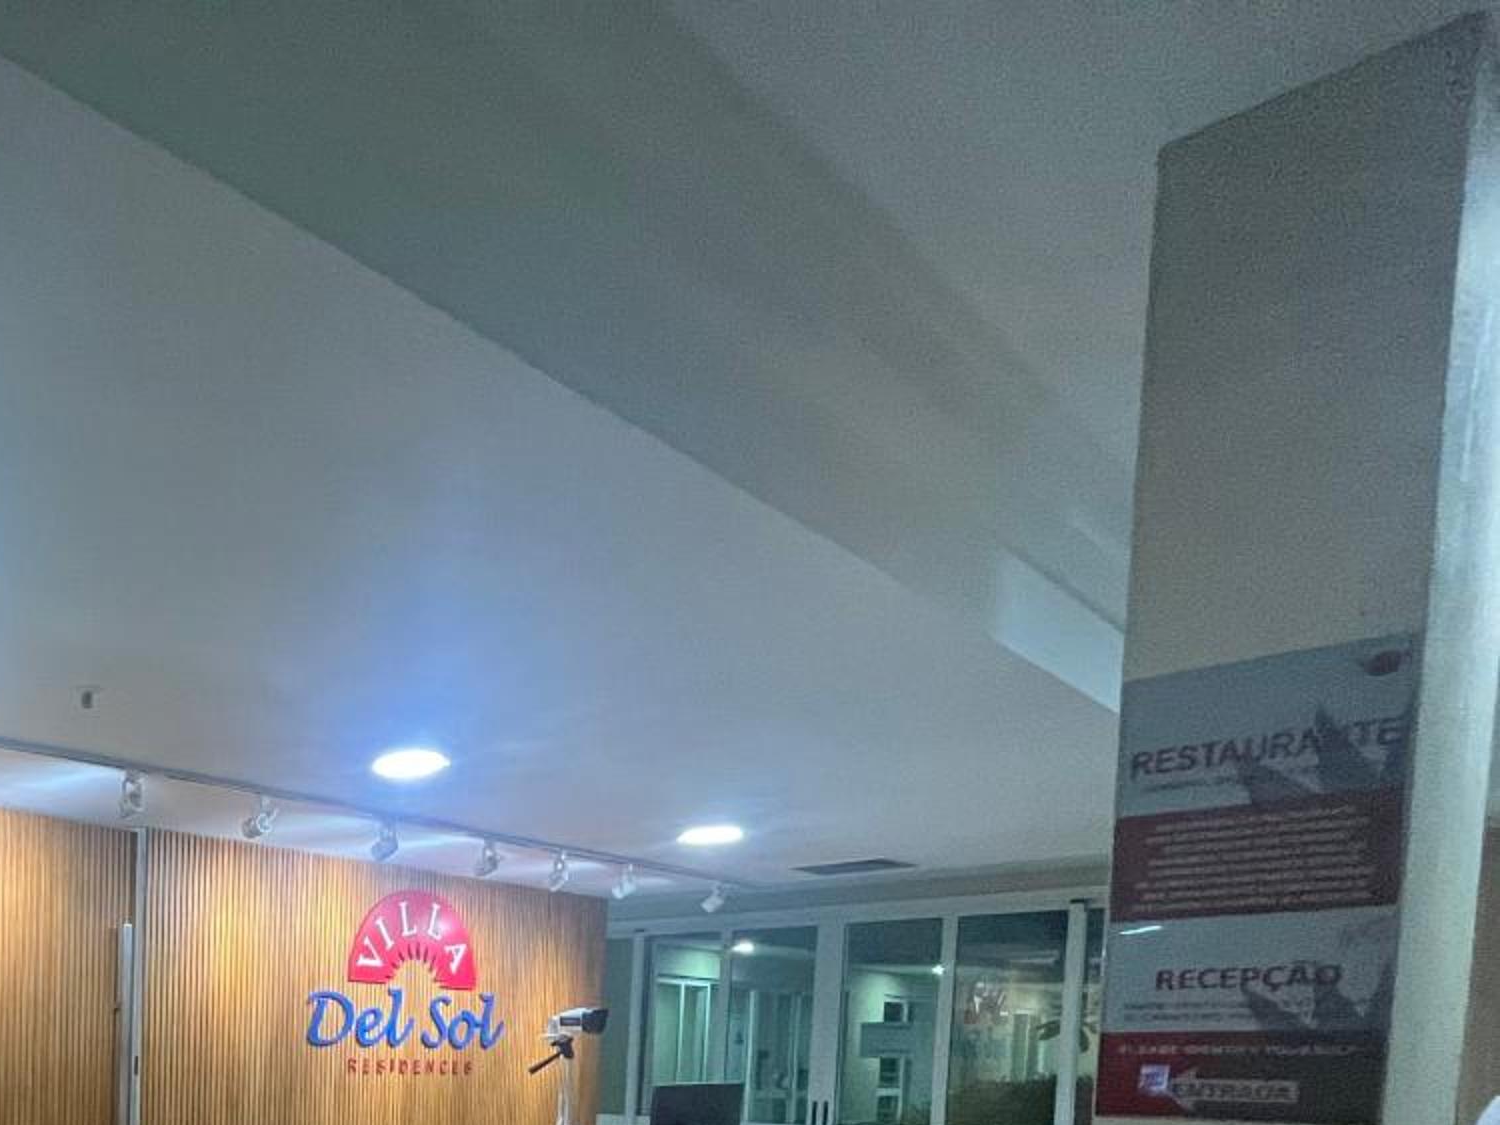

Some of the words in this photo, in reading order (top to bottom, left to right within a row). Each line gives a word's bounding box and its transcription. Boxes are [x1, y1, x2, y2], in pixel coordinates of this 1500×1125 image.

[356, 901, 468, 976] VILLA
[1154, 960, 1344, 992] RECEPÇÃO
[306, 987, 415, 1048] Del
[421, 992, 505, 1049] Sol
